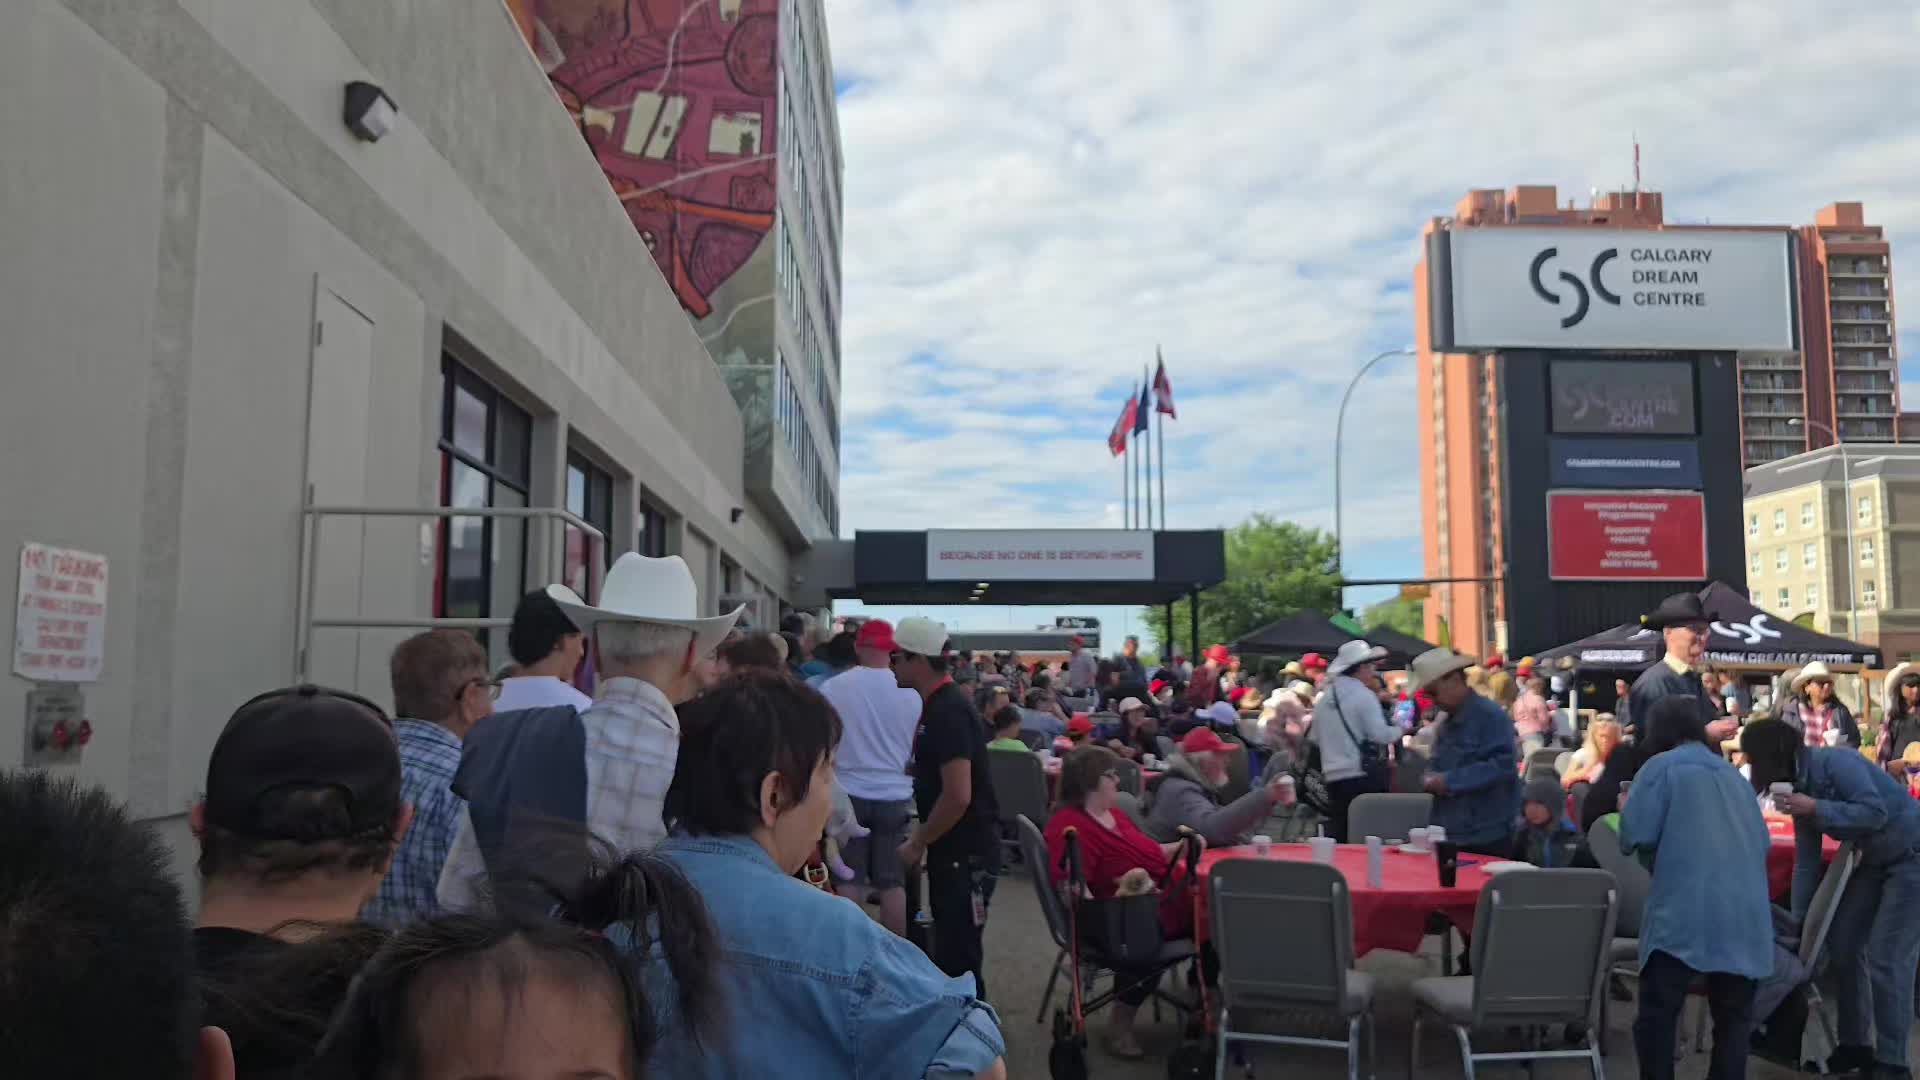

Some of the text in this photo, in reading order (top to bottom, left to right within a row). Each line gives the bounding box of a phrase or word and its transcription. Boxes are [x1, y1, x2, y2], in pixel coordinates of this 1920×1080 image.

[1630, 249, 1712, 264] CALGARY
[1632, 271, 1698, 284] DREAM
[1633, 292, 1706, 306] CENTRE
[940, 551, 994, 561] BECAUSE
[997, 551, 1015, 561] NO
[1018, 551, 1041, 561] ONE
[1046, 551, 1057, 561] IS
[1059, 551, 1106, 561] BEYOND
[1748, 652, 1797, 664] DREAM
